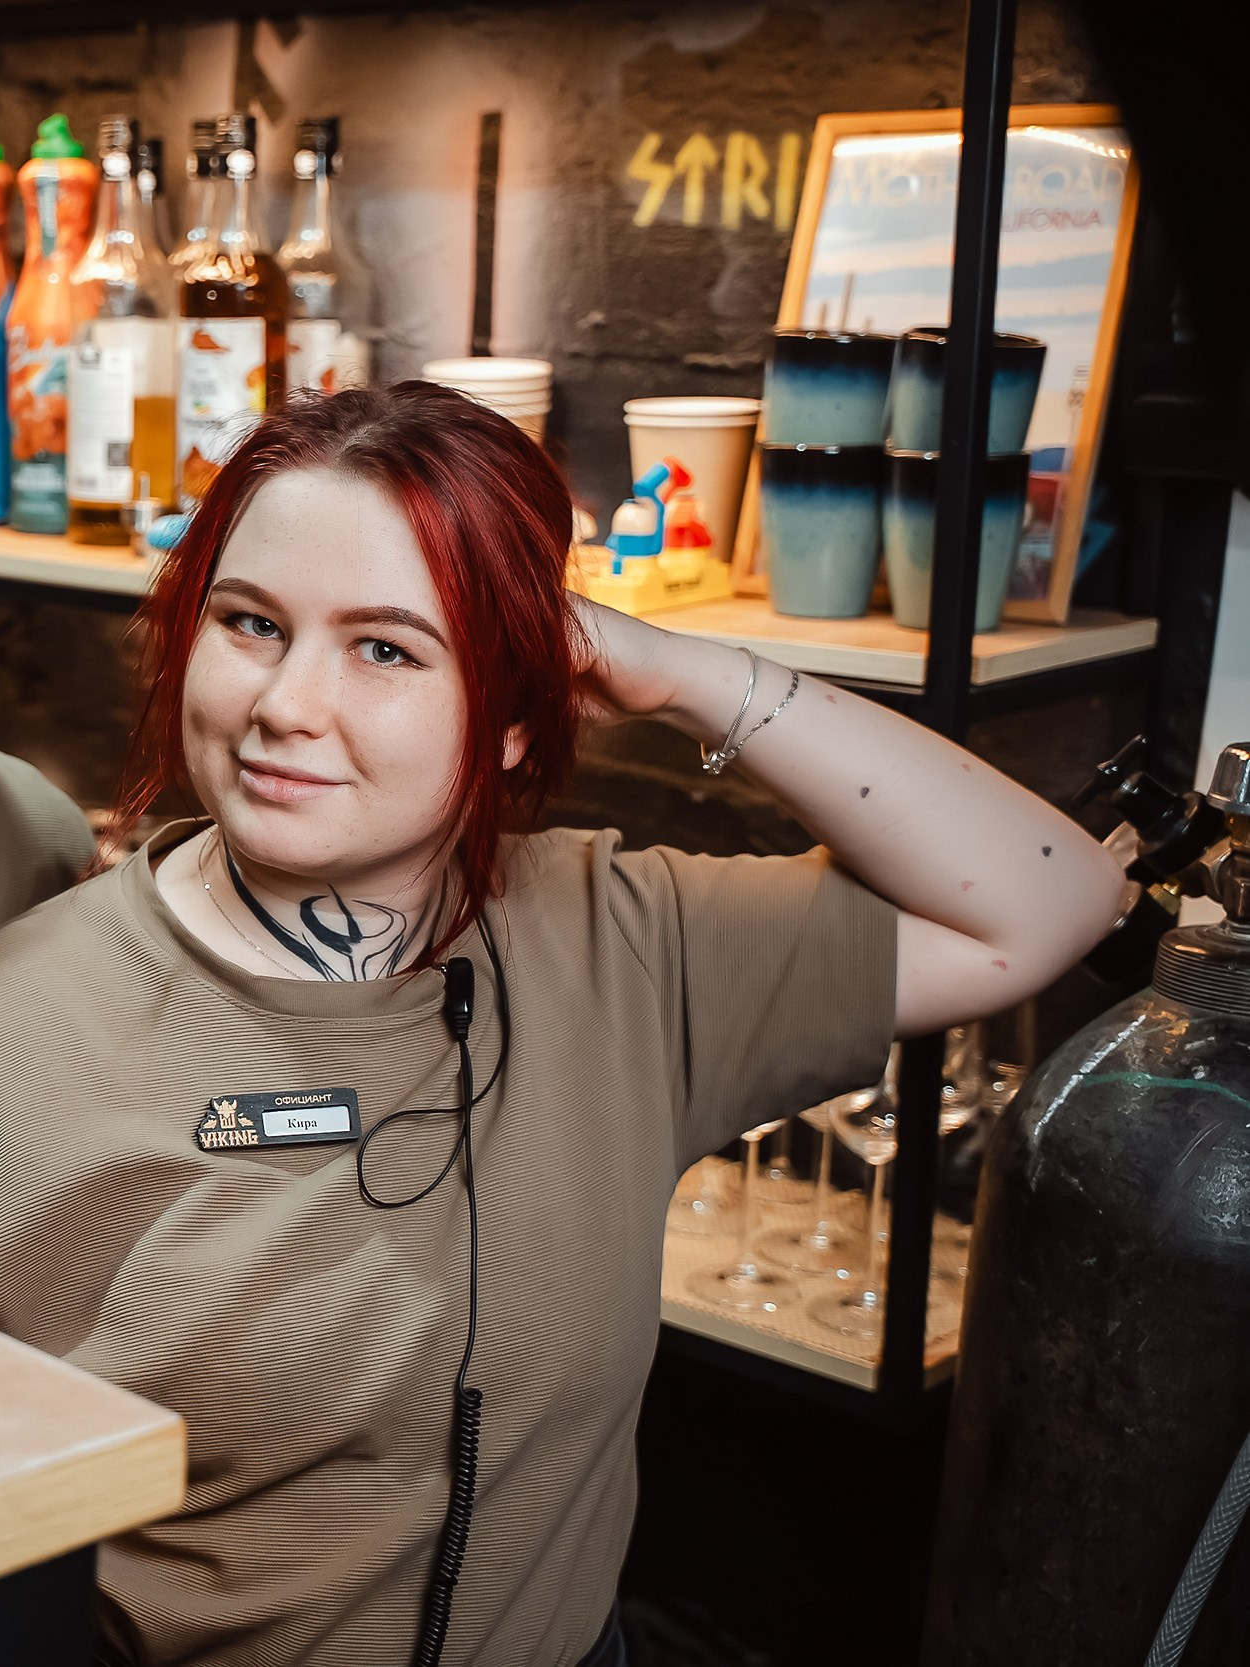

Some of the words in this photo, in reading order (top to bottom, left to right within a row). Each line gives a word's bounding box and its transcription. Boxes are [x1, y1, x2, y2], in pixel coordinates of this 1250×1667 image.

[274, 1093, 332, 1106] ОФИЦИАНТ
[287, 1119, 318, 1131] Кира
[200, 1129, 258, 1149] VIKING
